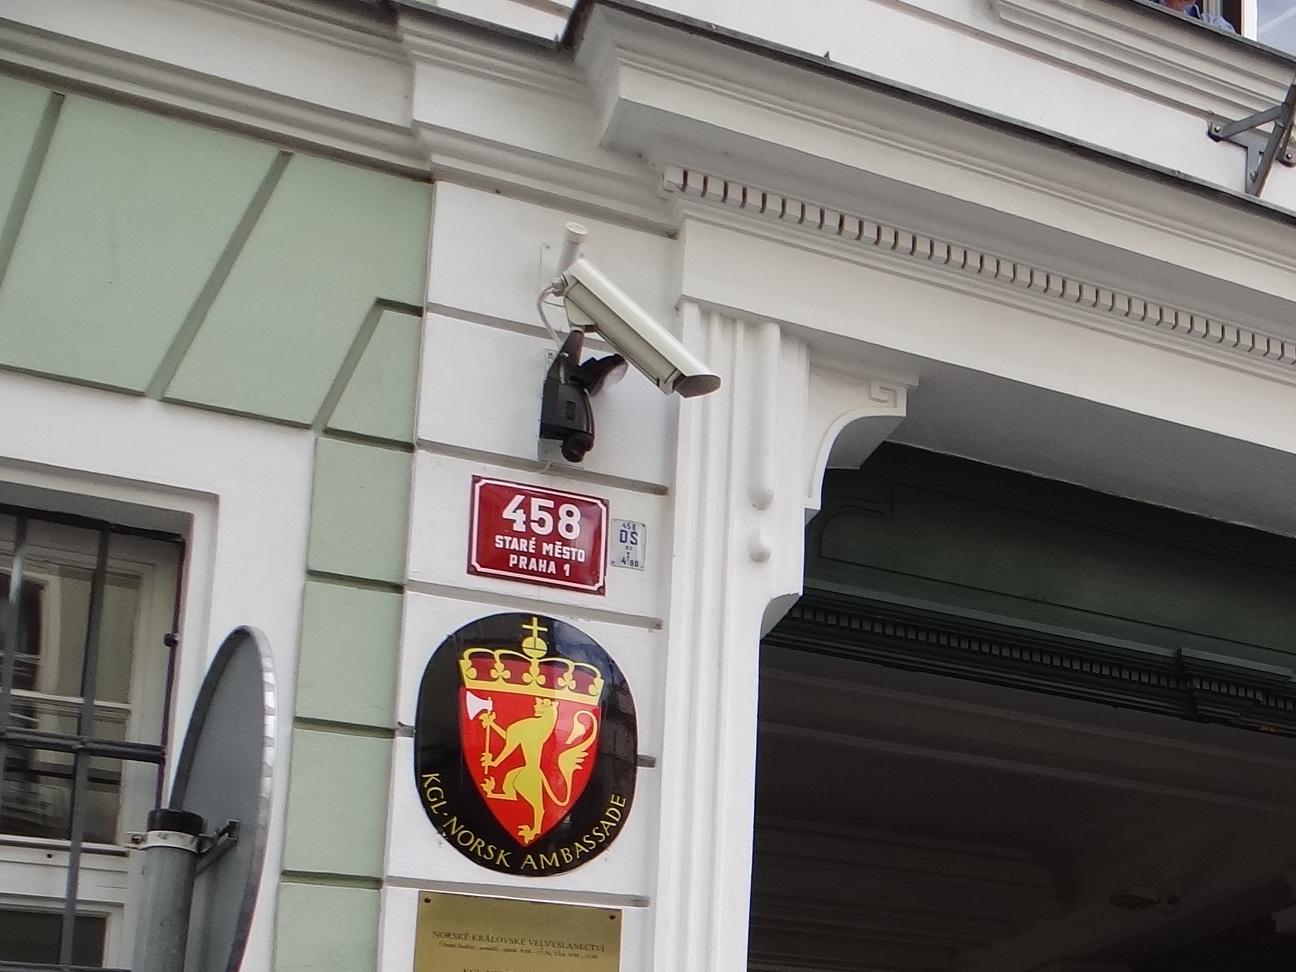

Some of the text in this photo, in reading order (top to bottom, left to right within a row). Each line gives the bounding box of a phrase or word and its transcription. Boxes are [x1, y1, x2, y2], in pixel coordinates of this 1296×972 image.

[502, 494, 581, 540] 458
[495, 535, 586, 562] STARÉ MĚSTO
[620, 530, 638, 545] DS
[509, 553, 570, 576] PRAHA 1
[442, 815, 512, 868] NORSK
[520, 793, 627, 870] AMBASSADE
